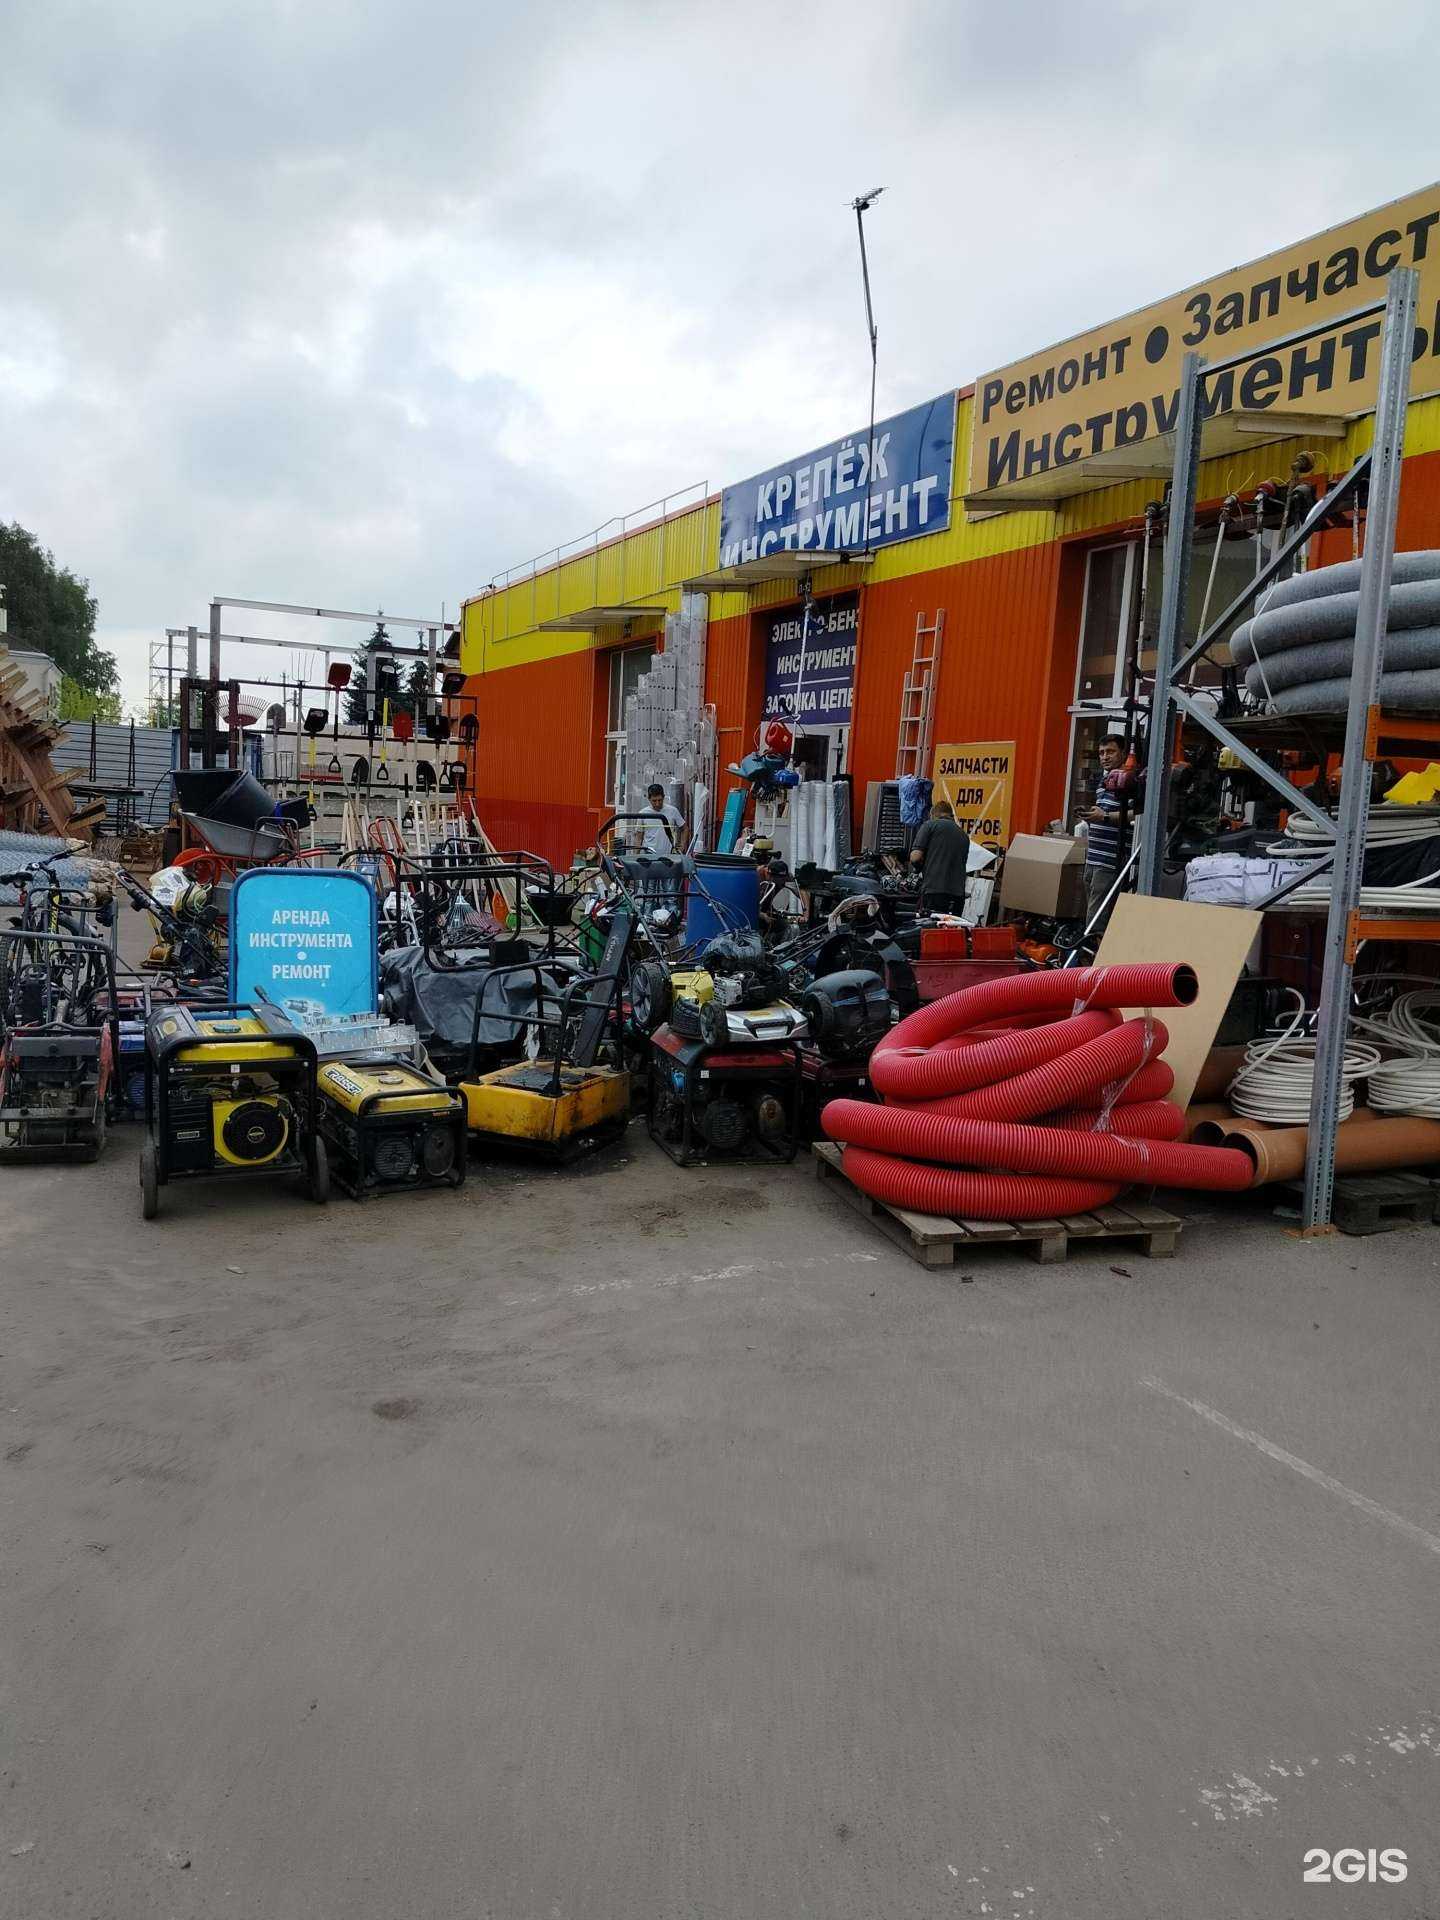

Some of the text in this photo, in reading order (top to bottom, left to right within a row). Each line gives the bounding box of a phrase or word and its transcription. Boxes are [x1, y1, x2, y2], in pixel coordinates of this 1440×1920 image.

[982, 335, 1131, 424] Ремонт
[757, 432, 890, 523] КРЕПЁЖ
[940, 757, 1009, 775] ЗАПЧАСТИ
[956, 788, 984, 807] ДЛЯ
[272, 910, 330, 927] АРЕНДА
[249, 932, 353, 948] ИНСТРУМЕНТА
[272, 964, 331, 979] РЕМОНТ
